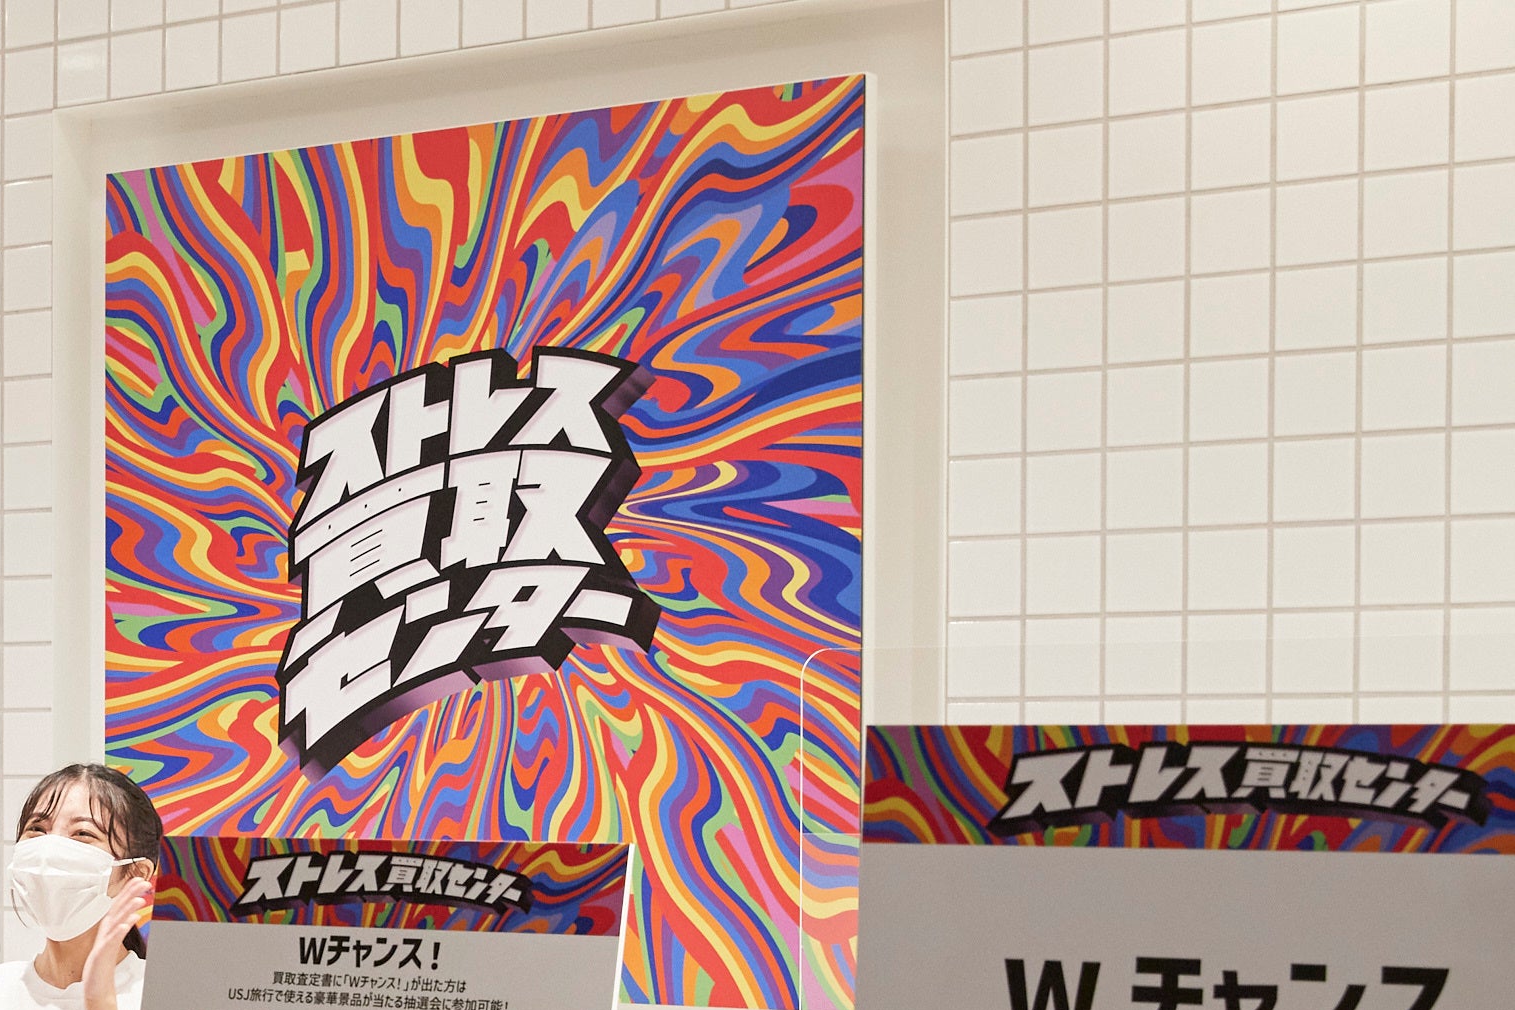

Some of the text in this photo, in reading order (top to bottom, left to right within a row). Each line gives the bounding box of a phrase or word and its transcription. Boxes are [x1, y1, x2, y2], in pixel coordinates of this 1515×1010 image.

[296, 354, 622, 532] ストレス
[294, 449, 612, 619] 買取
[283, 563, 635, 750] センター
[1006, 747, 1472, 821] ストレス買取センター
[238, 853, 523, 905] ストレス買取センター
